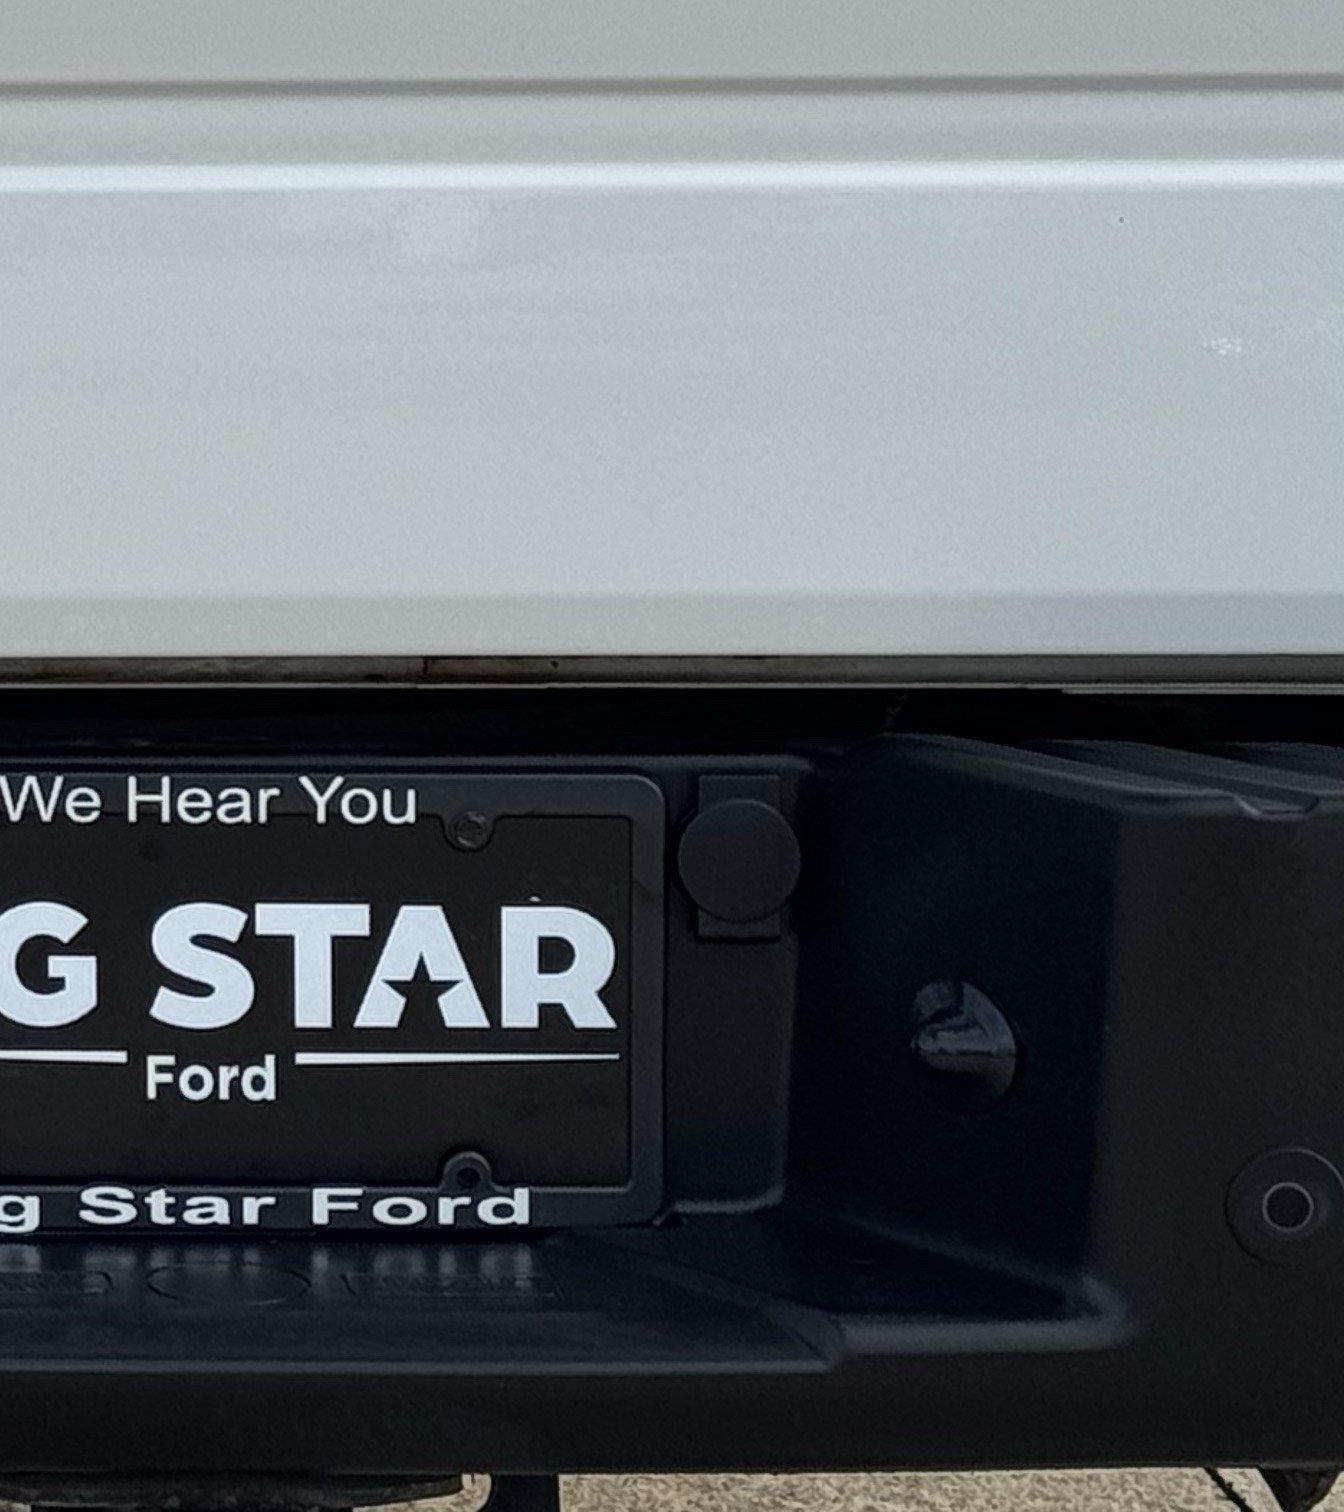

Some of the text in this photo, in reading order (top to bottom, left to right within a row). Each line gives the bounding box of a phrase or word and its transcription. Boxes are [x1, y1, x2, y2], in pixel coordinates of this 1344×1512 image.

[126, 774, 281, 824] Hear
[297, 774, 418, 825] You
[148, 901, 618, 1030] STAR
[145, 1054, 277, 1102] Ford
[78, 1185, 277, 1226] Star
[311, 1186, 532, 1227] Ford
